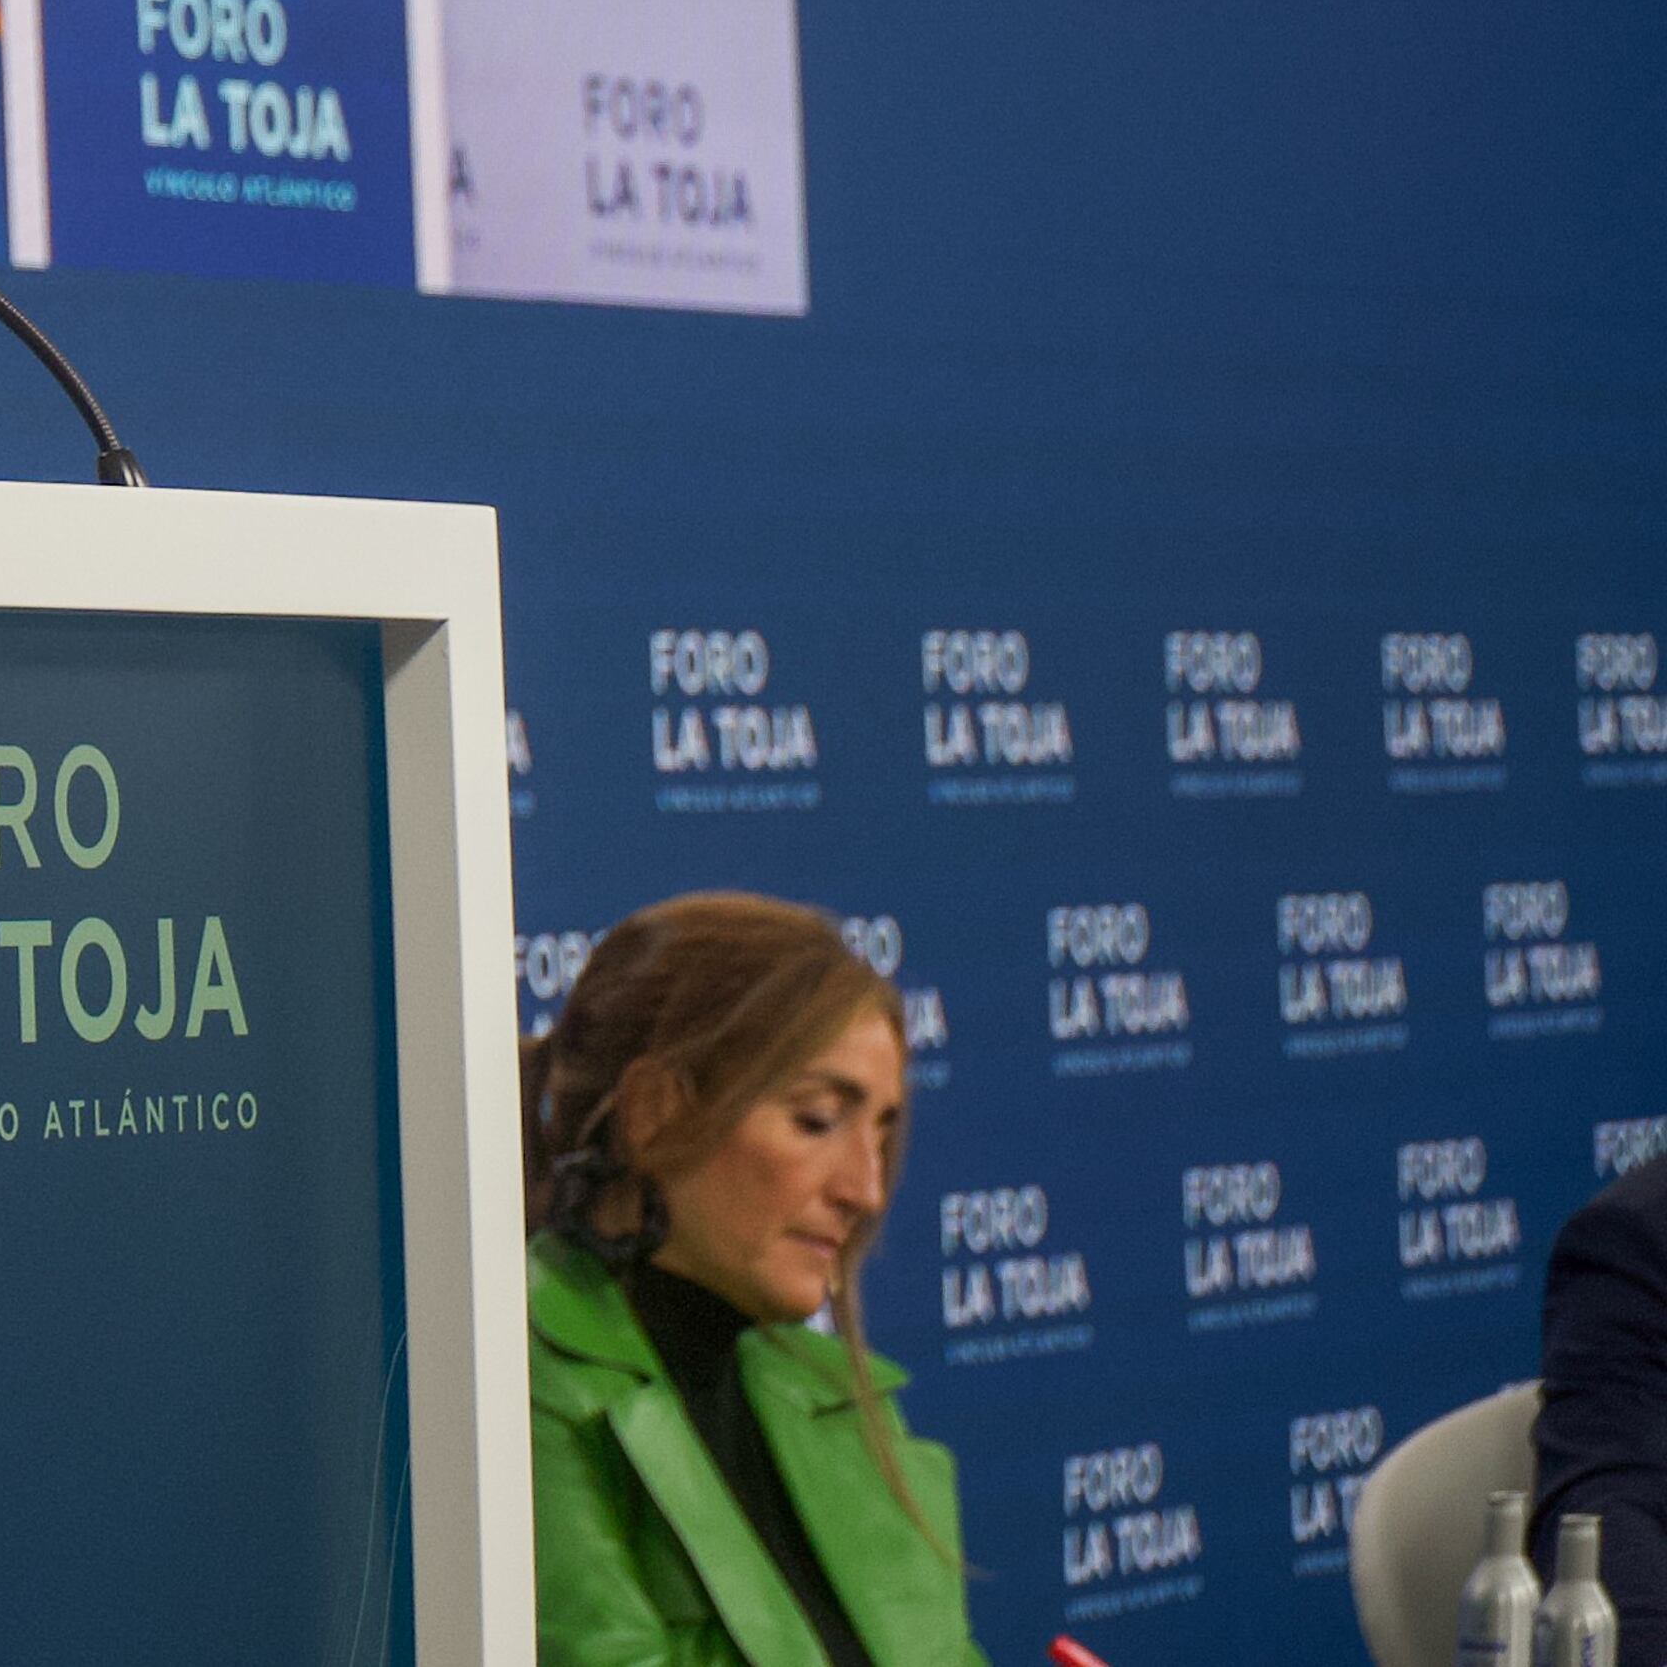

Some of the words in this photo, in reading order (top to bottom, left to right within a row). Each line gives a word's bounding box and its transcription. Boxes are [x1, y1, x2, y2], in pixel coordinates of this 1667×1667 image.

[140, 71, 212, 150] LA
[217, 78, 351, 163] TOJA
[583, 72, 703, 146] FORO
[584, 156, 639, 220] LA
[653, 160, 753, 227] TOJA
[649, 630, 768, 697] FORO
[921, 630, 1029, 694] FORO
[1164, 630, 1262, 693] FORO
[1380, 632, 1471, 693] FORO
[652, 705, 710, 772] LA
[713, 704, 819, 771] TOJA
[924, 701, 977, 767] LA
[980, 701, 1074, 766] TOJA
[1167, 699, 1215, 762] LA
[1216, 699, 1301, 762] TOJA
[1383, 698, 1427, 759] LA
[1047, 903, 1150, 968] FORO
[1277, 892, 1372, 956] FORO
[1048, 976, 1101, 1039] LA
[1100, 972, 1191, 1036] TOJA
[1278, 961, 1328, 1024] LA
[43, 1088, 259, 1141] ATLÁNTICO
[1182, 1162, 1282, 1229] FORO
[1397, 1137, 1487, 1202] FORO
[940, 1185, 1048, 1256] FORO
[1398, 1211, 1442, 1268] LA
[1442, 1198, 1521, 1260] TOJA
[941, 1265, 994, 1328] LA
[994, 1252, 1092, 1320] TOJA
[1184, 1237, 1233, 1298] LA
[1235, 1226, 1317, 1291] TOJA
[1289, 1405, 1385, 1475] FORO
[1064, 1442, 1163, 1517] FORO
[1290, 1482, 1338, 1543] LA
[1064, 1525, 1113, 1586] LA
[1114, 1505, 1202, 1575] TOJA
